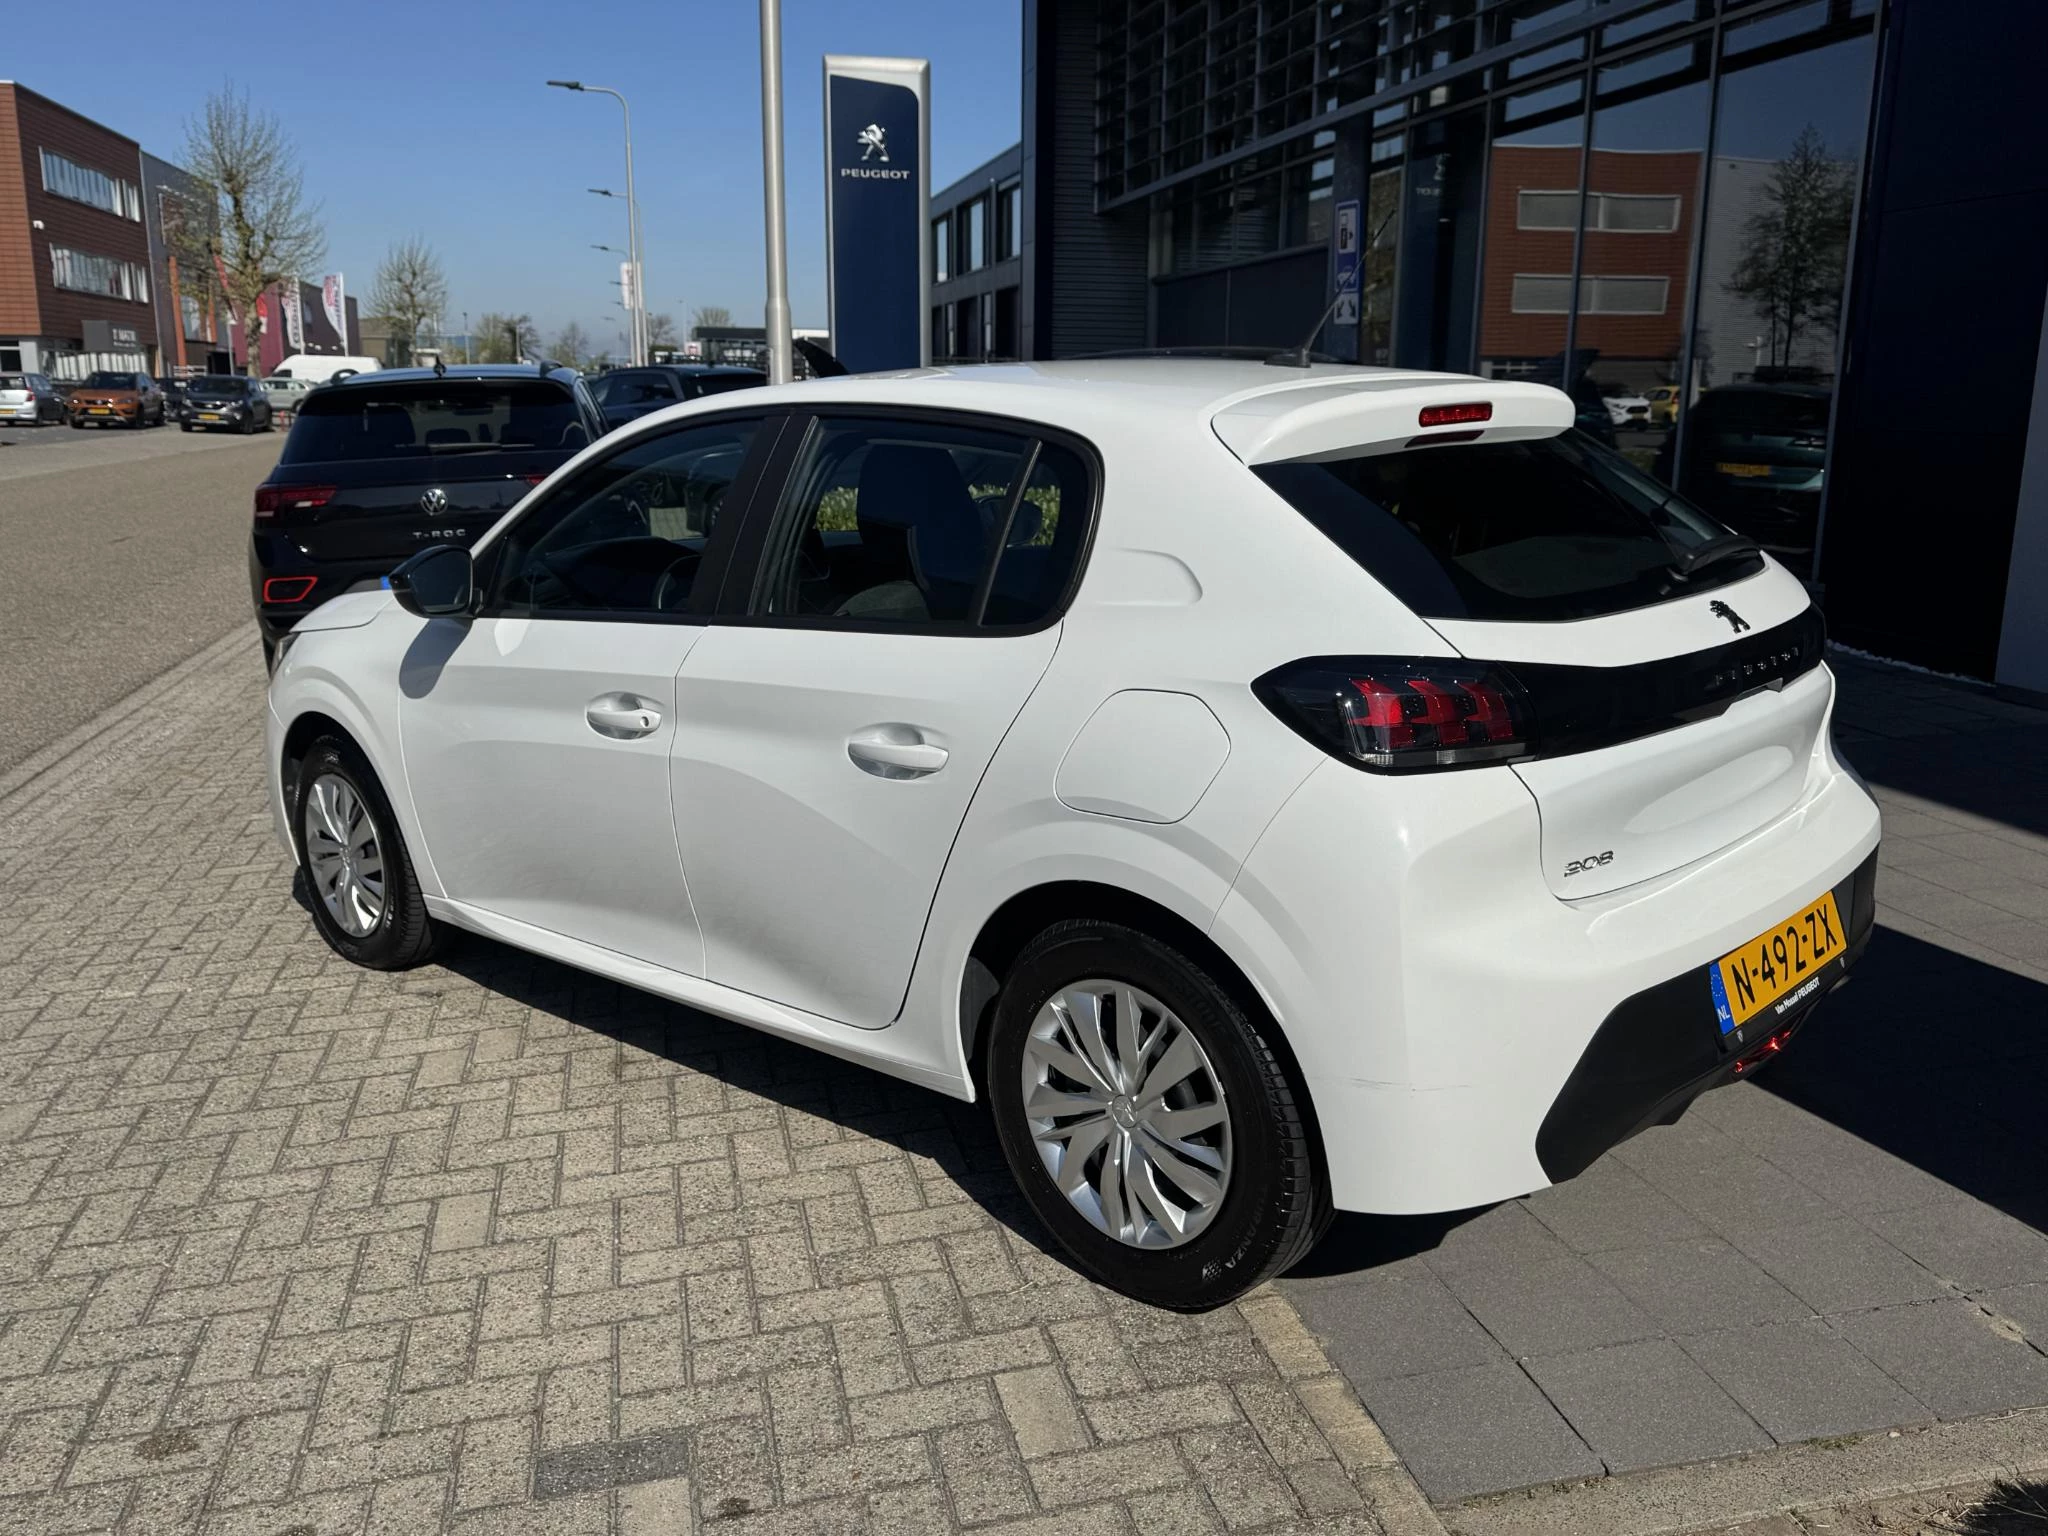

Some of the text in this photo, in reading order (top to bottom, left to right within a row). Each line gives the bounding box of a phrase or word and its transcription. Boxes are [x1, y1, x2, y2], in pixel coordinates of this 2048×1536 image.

[840, 168, 910, 180] PEUGEOT
[412, 528, 466, 539] T-ROC
[1564, 850, 1614, 878] 208
[1731, 903, 1838, 1011] N-492-ZX
[1797, 976, 1820, 999] PEUGEOT
[1716, 1005, 1731, 1023] NL
